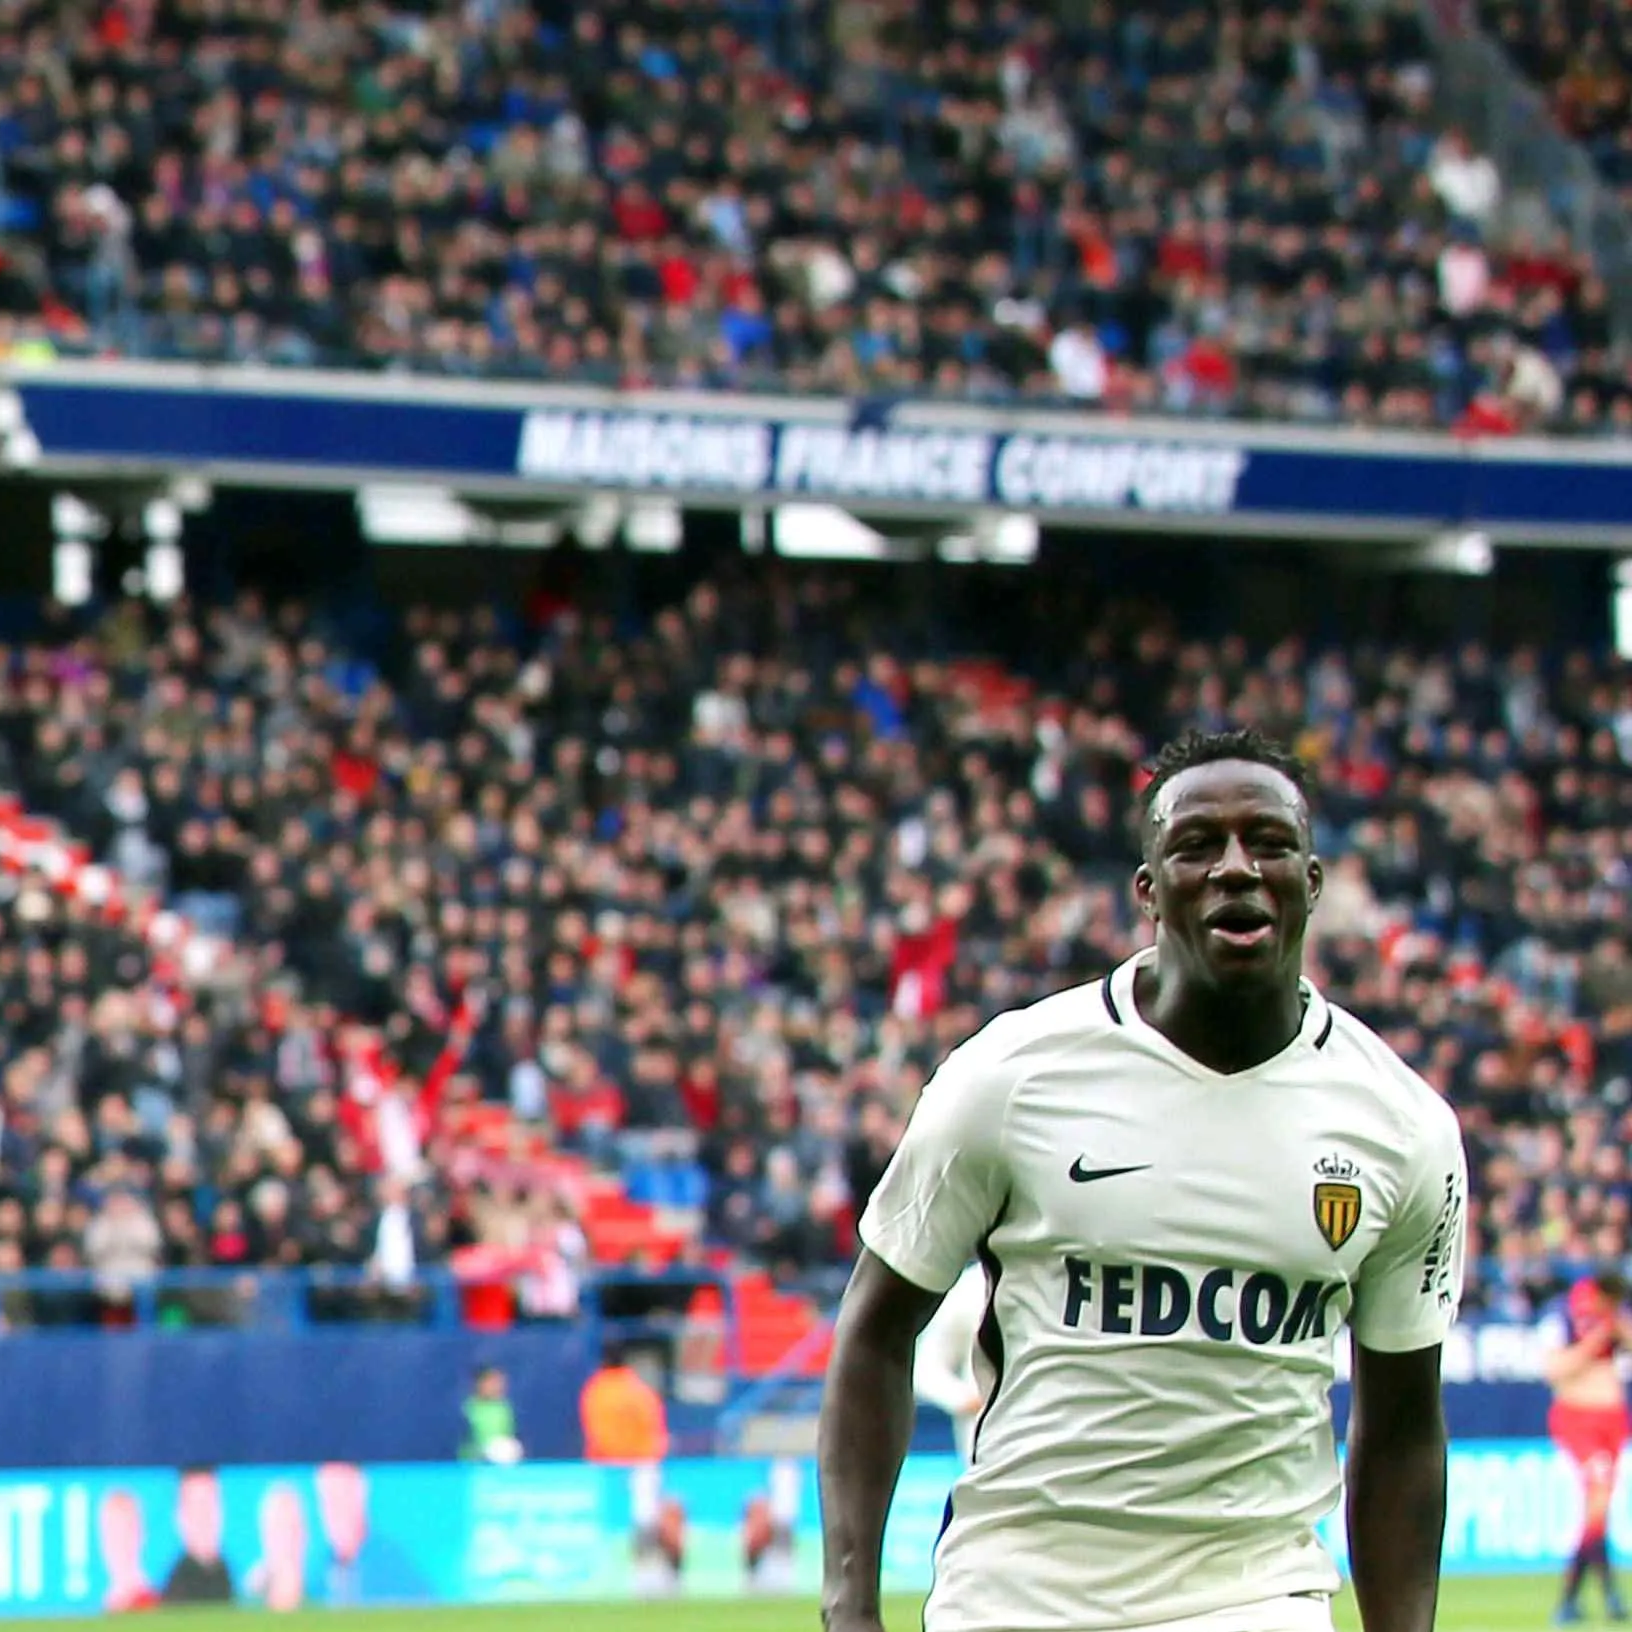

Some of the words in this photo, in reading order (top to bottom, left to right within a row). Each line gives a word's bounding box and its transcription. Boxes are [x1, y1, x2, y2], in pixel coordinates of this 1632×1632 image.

[517, 408, 770, 490] MAISONS
[774, 420, 993, 502] FRANCE
[995, 434, 1246, 512] CONFORT
[1063, 1255, 1345, 1345] FEDCOM
